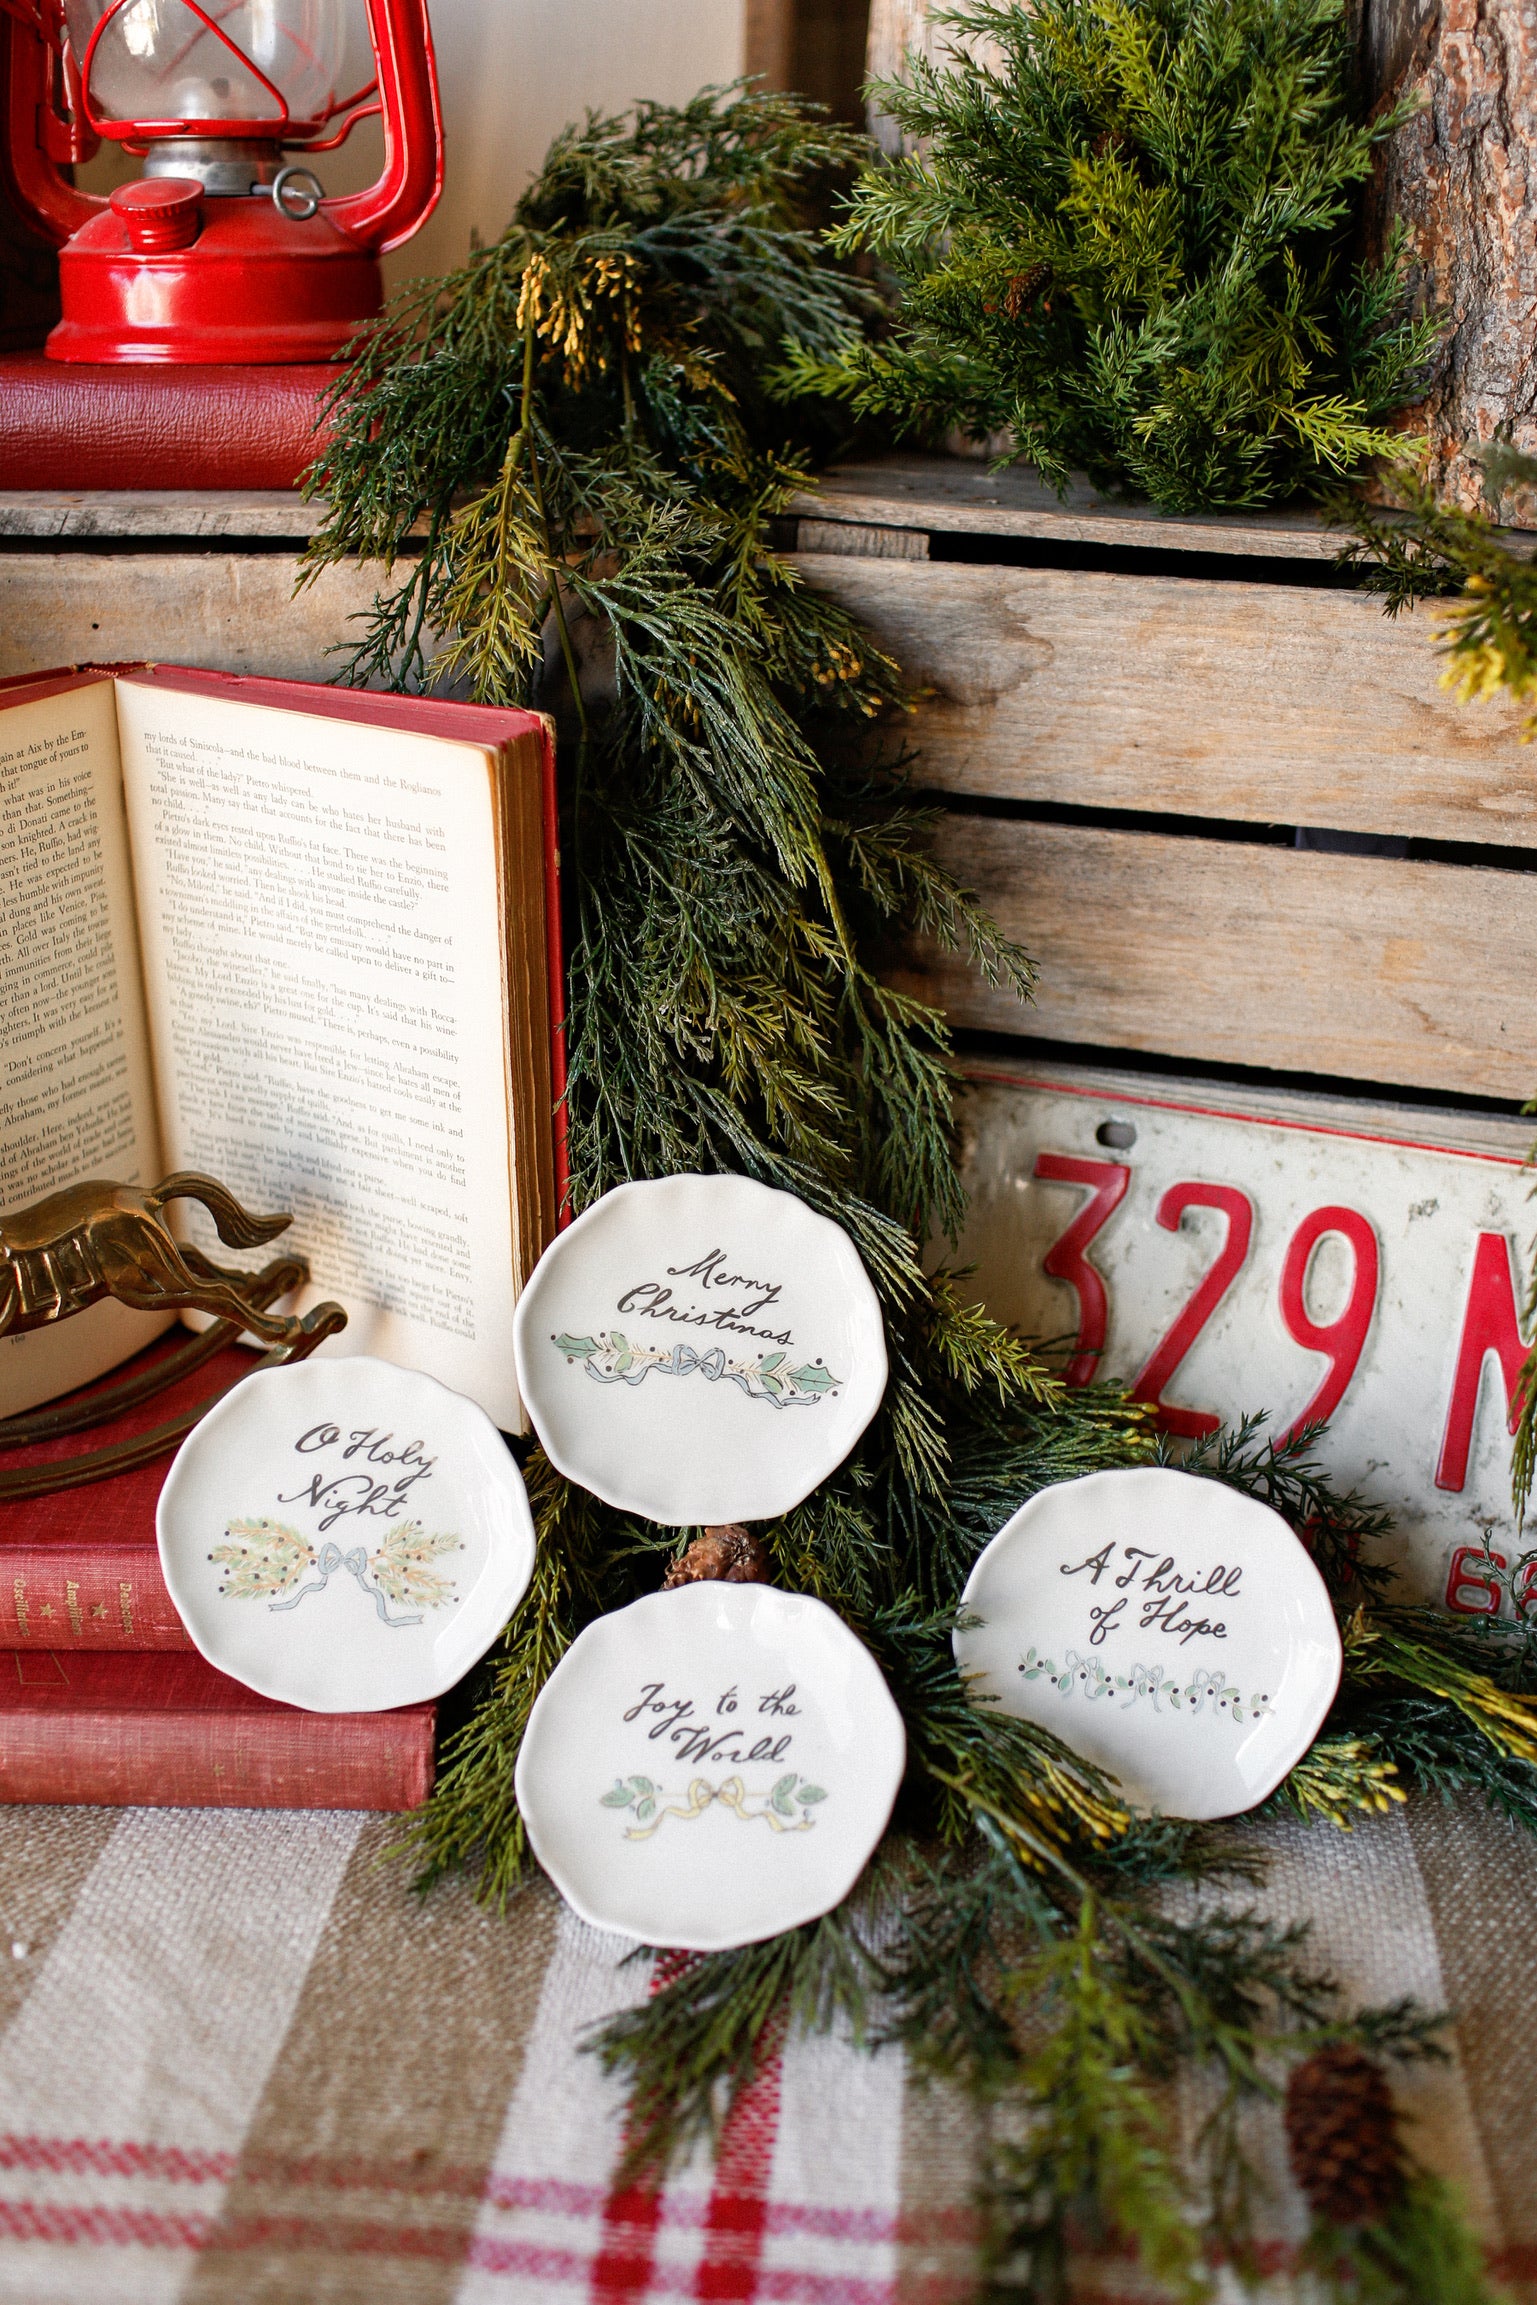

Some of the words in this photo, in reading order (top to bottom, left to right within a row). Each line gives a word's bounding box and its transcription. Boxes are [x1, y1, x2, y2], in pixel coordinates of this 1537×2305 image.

[0, 752, 13, 763] ain
[16, 747, 24, 758] at
[27, 743, 41, 755] Aix
[44, 738, 53, 752] by
[56, 733, 68, 746] the
[71, 730, 86, 741] Em-
[0, 764, 17, 778] that
[19, 757, 47, 772] tongue
[48, 750, 57, 762] of
[59, 747, 80, 762] yours
[80, 742, 88, 752] to
[143, 732, 156, 743] my
[158, 732, 177, 745] lords
[178, 736, 187, 746] of
[246, 750, 259, 760] the
[262, 752, 276, 764] bad
[278, 755, 300, 768] blood
[303, 760, 337, 776] between
[339, 768, 361, 780] them
[363, 774, 379, 784] and
[382, 776, 396, 787] the
[400, 779, 441, 796] Roglianos
[4, 791, 24, 806] what
[28, 787, 43, 798] was
[46, 782, 55, 792] in
[58, 777, 70, 788] his
[72, 771, 92, 783] voice
[157, 769, 176, 782] "She
[179, 774, 186, 784] is
[188, 777, 219, 791] well—as
[222, 784, 239, 795] well
[253, 792, 267, 804] any
[270, 792, 287, 808] lady
[290, 800, 304, 808] can
[308, 800, 318, 811] be
[321, 804, 339, 815] who
[342, 807, 364, 821] hates
[367, 812, 381, 824] her
[385, 816, 421, 832] husband
[425, 826, 445, 837] with
[2, 808, 21, 821] than
[24, 800, 44, 813] that.
[6, 823, 16, 834] di
[20, 812, 47, 830] Donati
[50, 807, 70, 819] came
[73, 802, 81, 812] to
[83, 796, 96, 808] the
[149, 782, 167, 794] total
[169, 788, 199, 800] passion.
[202, 792, 225, 808] Many
[227, 800, 240, 812] say
[242, 800, 258, 812] that
[260, 804, 276, 816] that
[278, 810, 312, 823] accounts
[314, 814, 326, 826] for
[329, 818, 342, 829] the
[345, 821, 360, 833] fact
[363, 825, 380, 837] that
[383, 830, 405, 842] there
[408, 834, 422, 846] has
[425, 838, 446, 851] been
[0, 840, 15, 850] son
[18, 824, 56, 845] knighted.
[58, 820, 65, 831] A
[67, 812, 87, 828] crack
[89, 811, 97, 821] in
[9, 879, 23, 890] He
[26, 873, 42, 884] was
[45, 856, 79, 878] expected
[82, 855, 90, 865] to
[93, 850, 102, 861] be
[22, 857, 38, 872] tied
[41, 856, 49, 865] to
[52, 849, 65, 862] the
[68, 841, 85, 856] land
[87, 836, 100, 847] any
[19, 883, 50, 901] humble
[51, 874, 69, 890] with
[70, 864, 104, 884] impunity
[8, 906, 30, 920] dung
[33, 896, 48, 911] and
[51, 893, 62, 904] his
[64, 888, 81, 899] own
[12, 918, 36, 936] places
[40, 909, 55, 922] like
[59, 901, 87, 915] Venice,
[16, 928, 37, 945] Gold
[40, 925, 56, 936] was
[58, 913, 87, 929] coming
[346, 915, 395, 932] comprehend
[397, 924, 411, 936] the
[413, 927, 441, 944] danger
[443, 935, 452, 946] of
[365, 945, 390, 956] would
[392, 948, 411, 961] have
[413, 956, 424, 964] no
[426, 959, 443, 970] part
[445, 962, 454, 972] in
[373, 957, 382, 967] to
[384, 958, 411, 974] deliver
[422, 969, 436, 981] gift
[439, 973, 455, 983] to—
[391, 1038, 410, 1049] even
[419, 1046, 458, 1066] possibility
[667, 1249, 782, 1316] Merry
[617, 1283, 794, 1345] Christmas
[1034, 1153, 1378, 1457] 329
[295, 1423, 340, 1453] O
[342, 1428, 438, 1492] Holy
[277, 1474, 407, 1531] Night
[1060, 1541, 1116, 1585] A
[1115, 1547, 1243, 1596] Thrill
[1089, 1598, 1129, 1645] of
[1139, 1595, 1227, 1646] Hope
[623, 1683, 695, 1739] Joy
[716, 1685, 738, 1715] to
[758, 1684, 802, 1716] the
[670, 1726, 792, 1763] World
